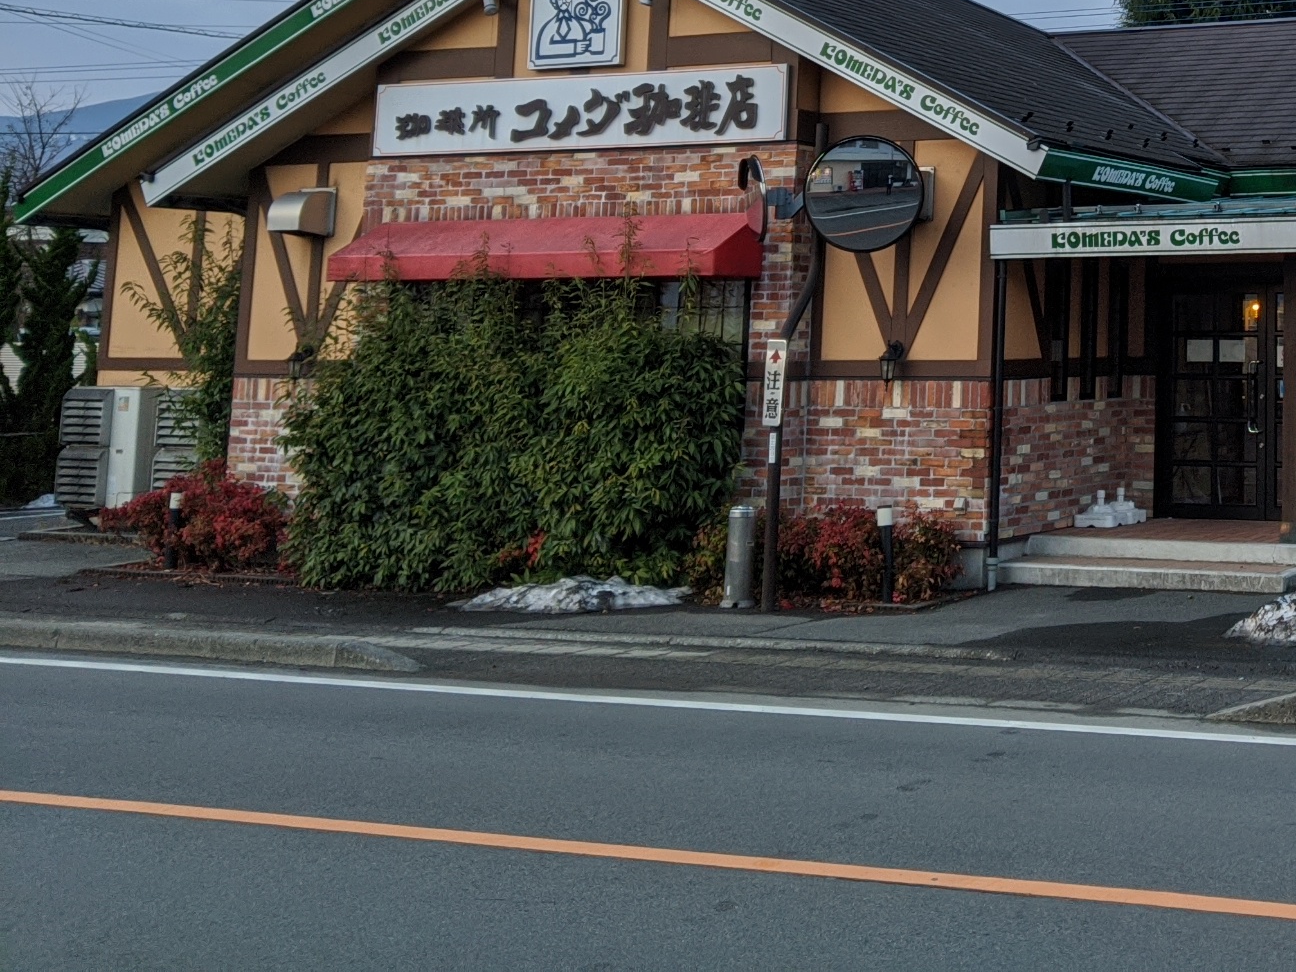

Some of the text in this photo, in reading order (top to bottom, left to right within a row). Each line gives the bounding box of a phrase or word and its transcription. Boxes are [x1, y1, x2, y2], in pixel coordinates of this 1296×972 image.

[101, 73, 218, 158] KOMEDA'S Coffee
[191, 71, 327, 167] KOMEDA'S Coffee
[819, 41, 980, 136] KOMEDA'S Coffee
[1091, 166, 1176, 193] KOMEDA'S Coffee
[1051, 227, 1241, 249] KOMEDA'S Coffee
[764, 370, 782, 420] 注意
